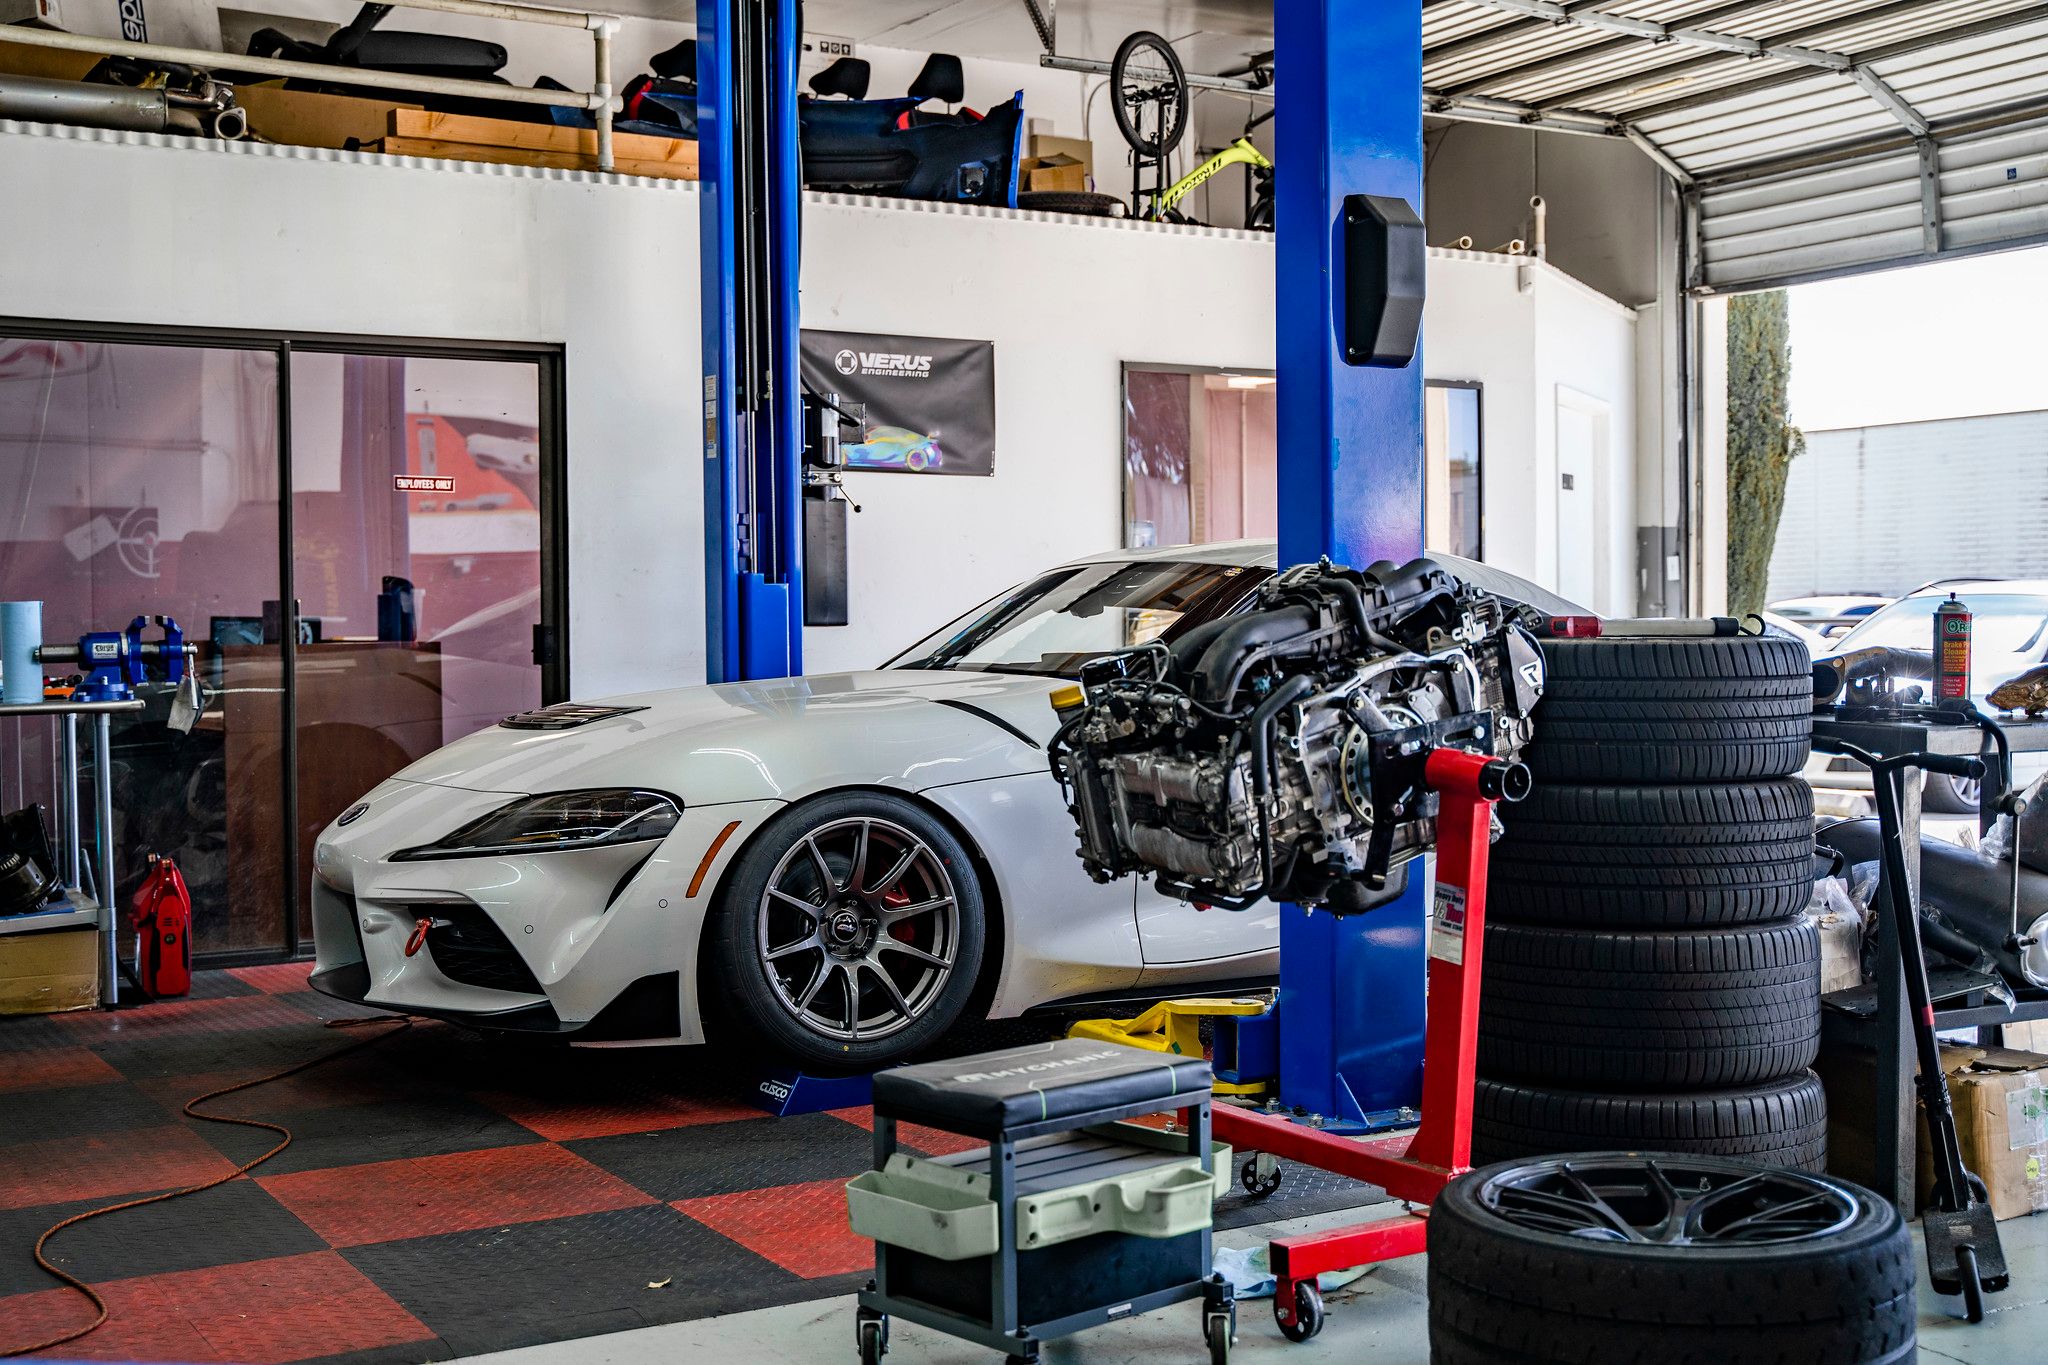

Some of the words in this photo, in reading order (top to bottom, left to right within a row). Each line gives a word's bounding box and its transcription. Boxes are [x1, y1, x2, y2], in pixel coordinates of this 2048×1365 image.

[1181, 167, 1211, 194] Razor
[859, 352, 933, 371] VERUS
[861, 368, 930, 377] ENGINEERING
[396, 478, 435, 489] EMPLOYEES
[435, 480, 452, 489] ONLY
[1943, 641, 1962, 649] Brake
[990, 1050, 1121, 1078] MYCHANIC
[760, 1082, 788, 1098] CUSCO
